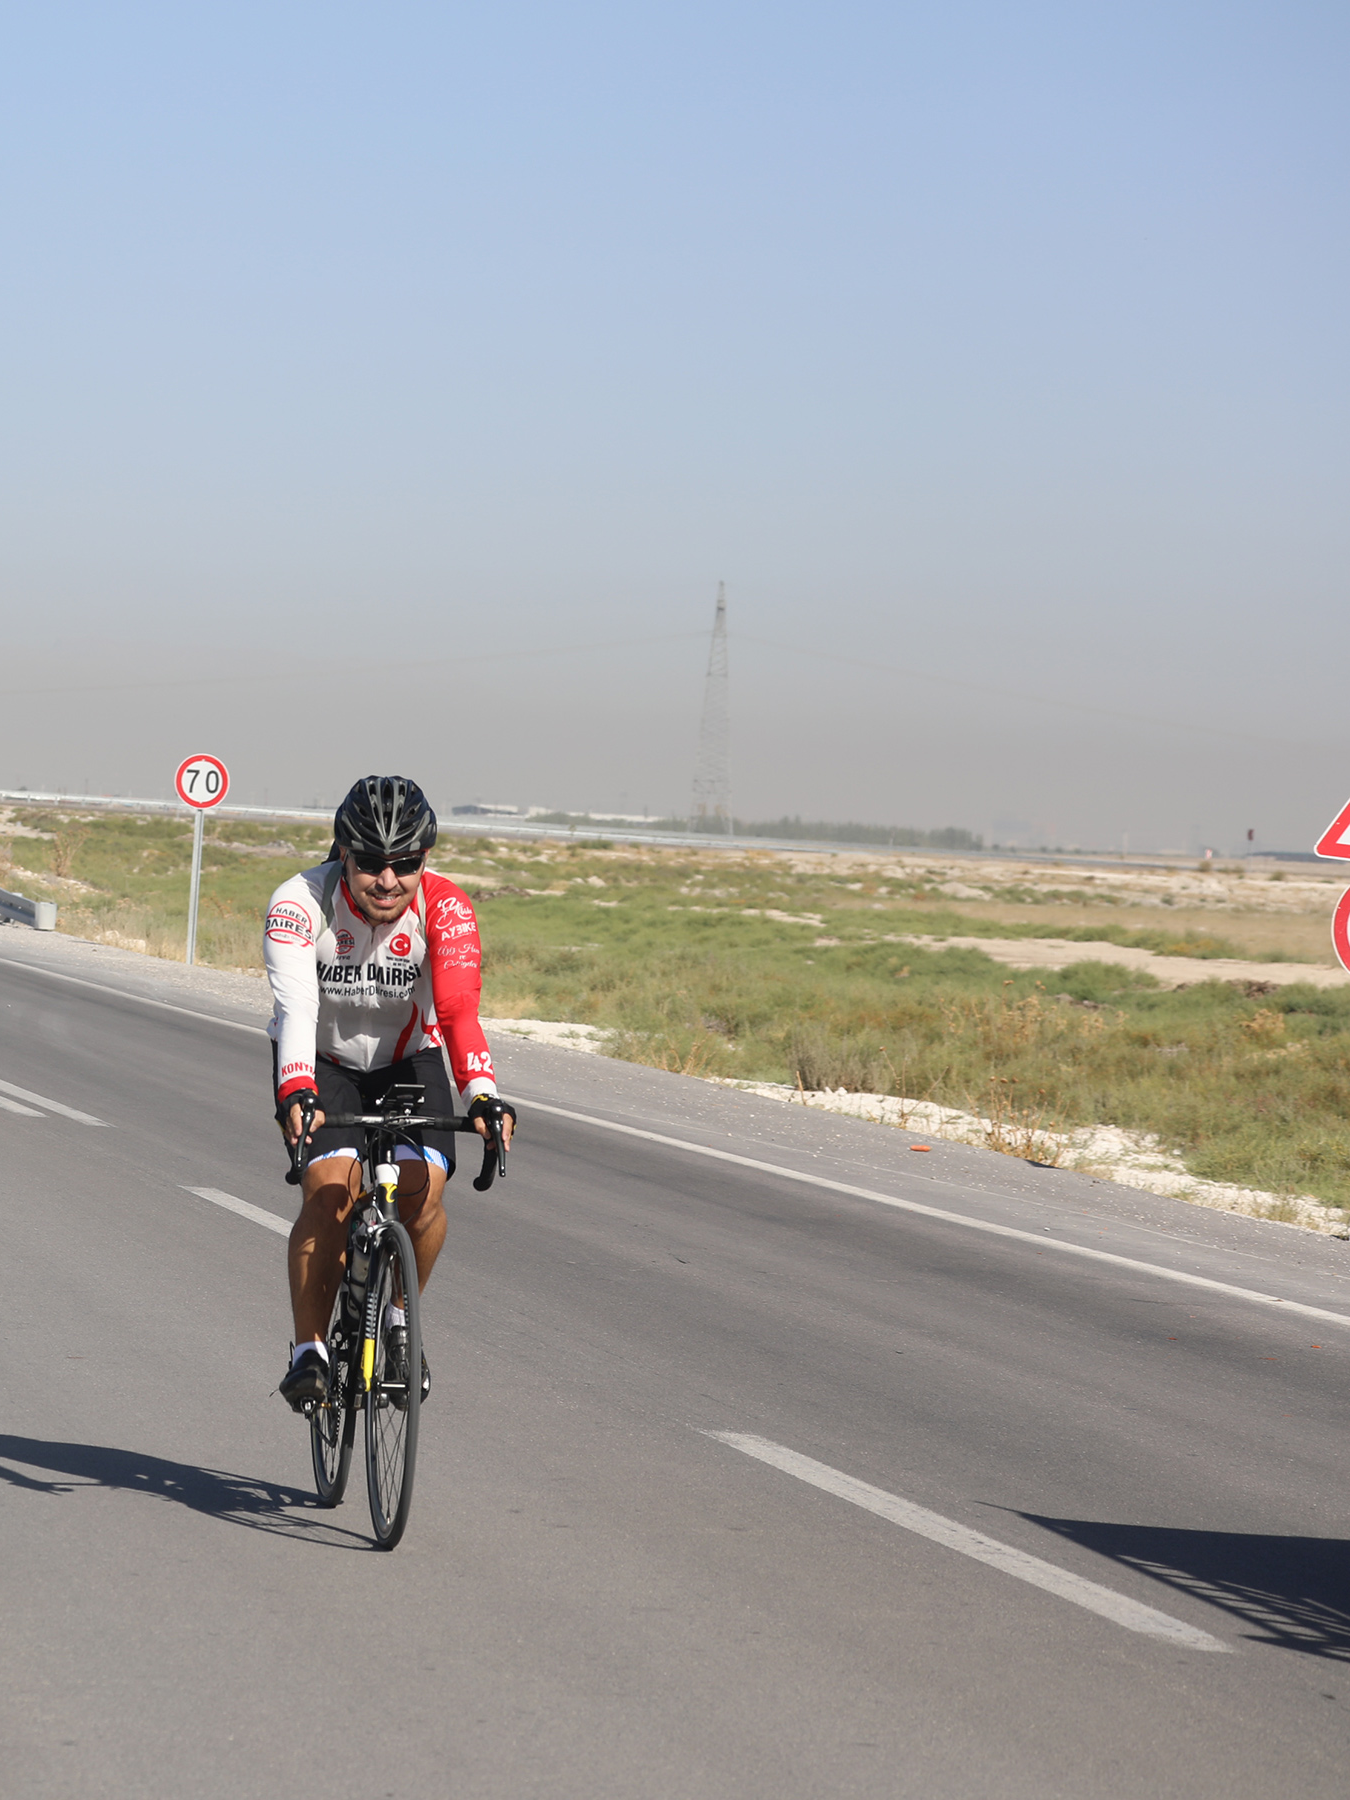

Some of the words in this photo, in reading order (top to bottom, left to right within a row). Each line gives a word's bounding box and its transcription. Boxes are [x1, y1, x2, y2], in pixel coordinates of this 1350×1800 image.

[187, 769, 219, 794] 70
[276, 907, 307, 924] HABER
[317, 960, 362, 984] HABER
[467, 1051, 494, 1075] 42
